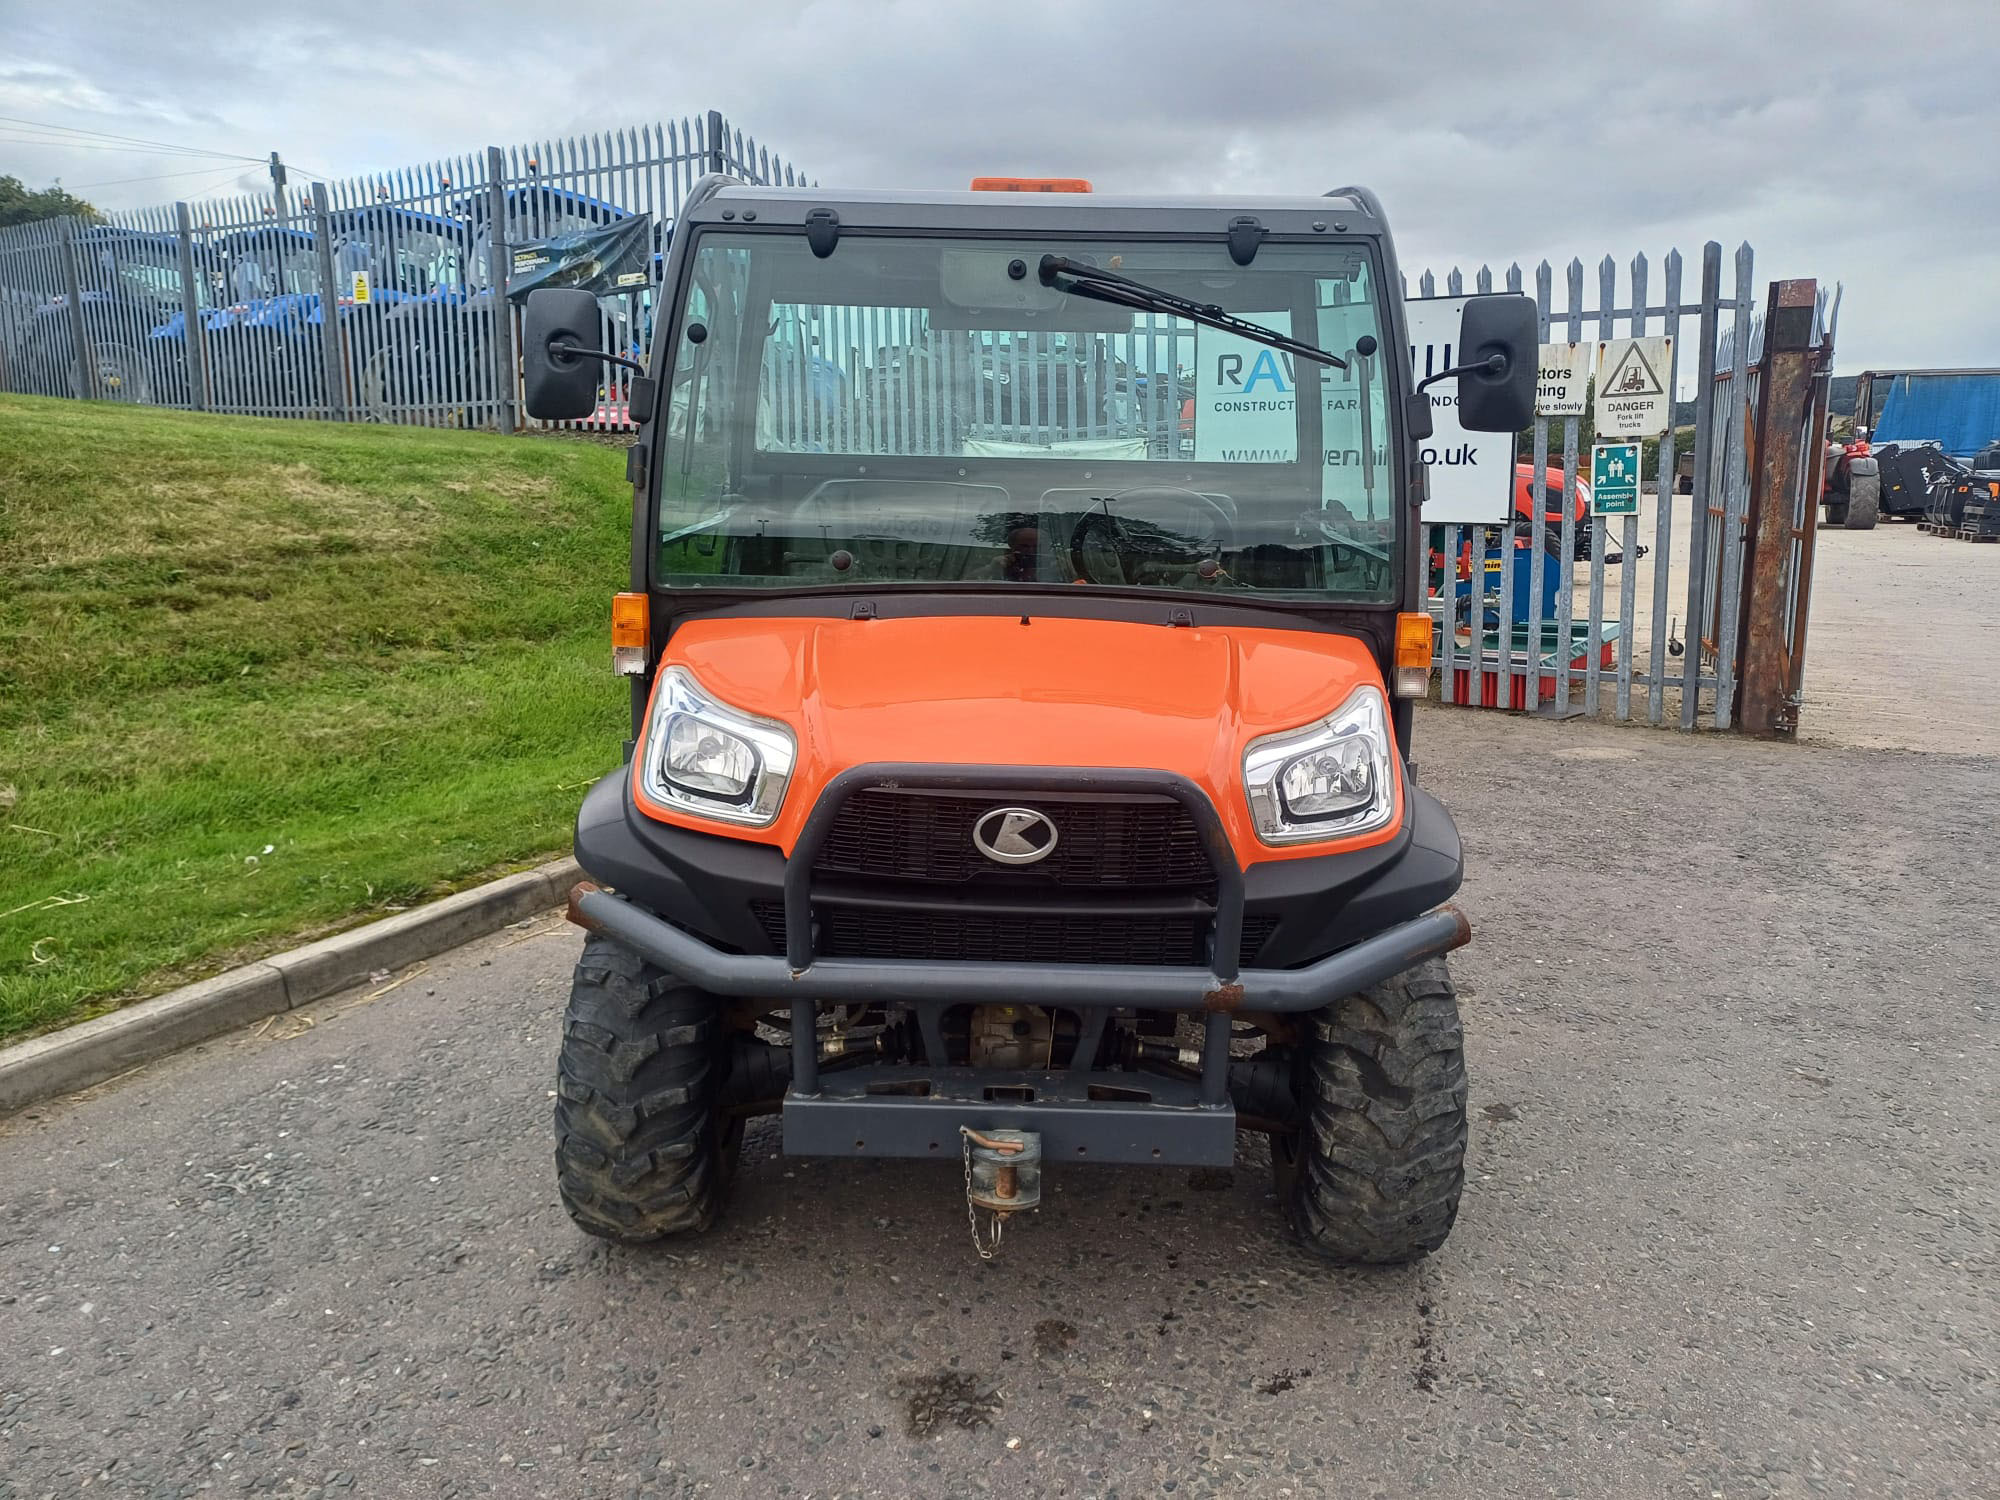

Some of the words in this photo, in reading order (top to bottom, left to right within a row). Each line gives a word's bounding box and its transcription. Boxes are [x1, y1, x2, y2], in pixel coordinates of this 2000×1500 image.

[1536, 384, 1566, 399] ning
[1214, 400, 1295, 412] CONSTRUCT
[1327, 400, 1359, 410] FAR
[1553, 402, 1582, 412] slowly
[1608, 401, 1654, 412] DANGER
[1598, 492, 1634, 501] Assembly
